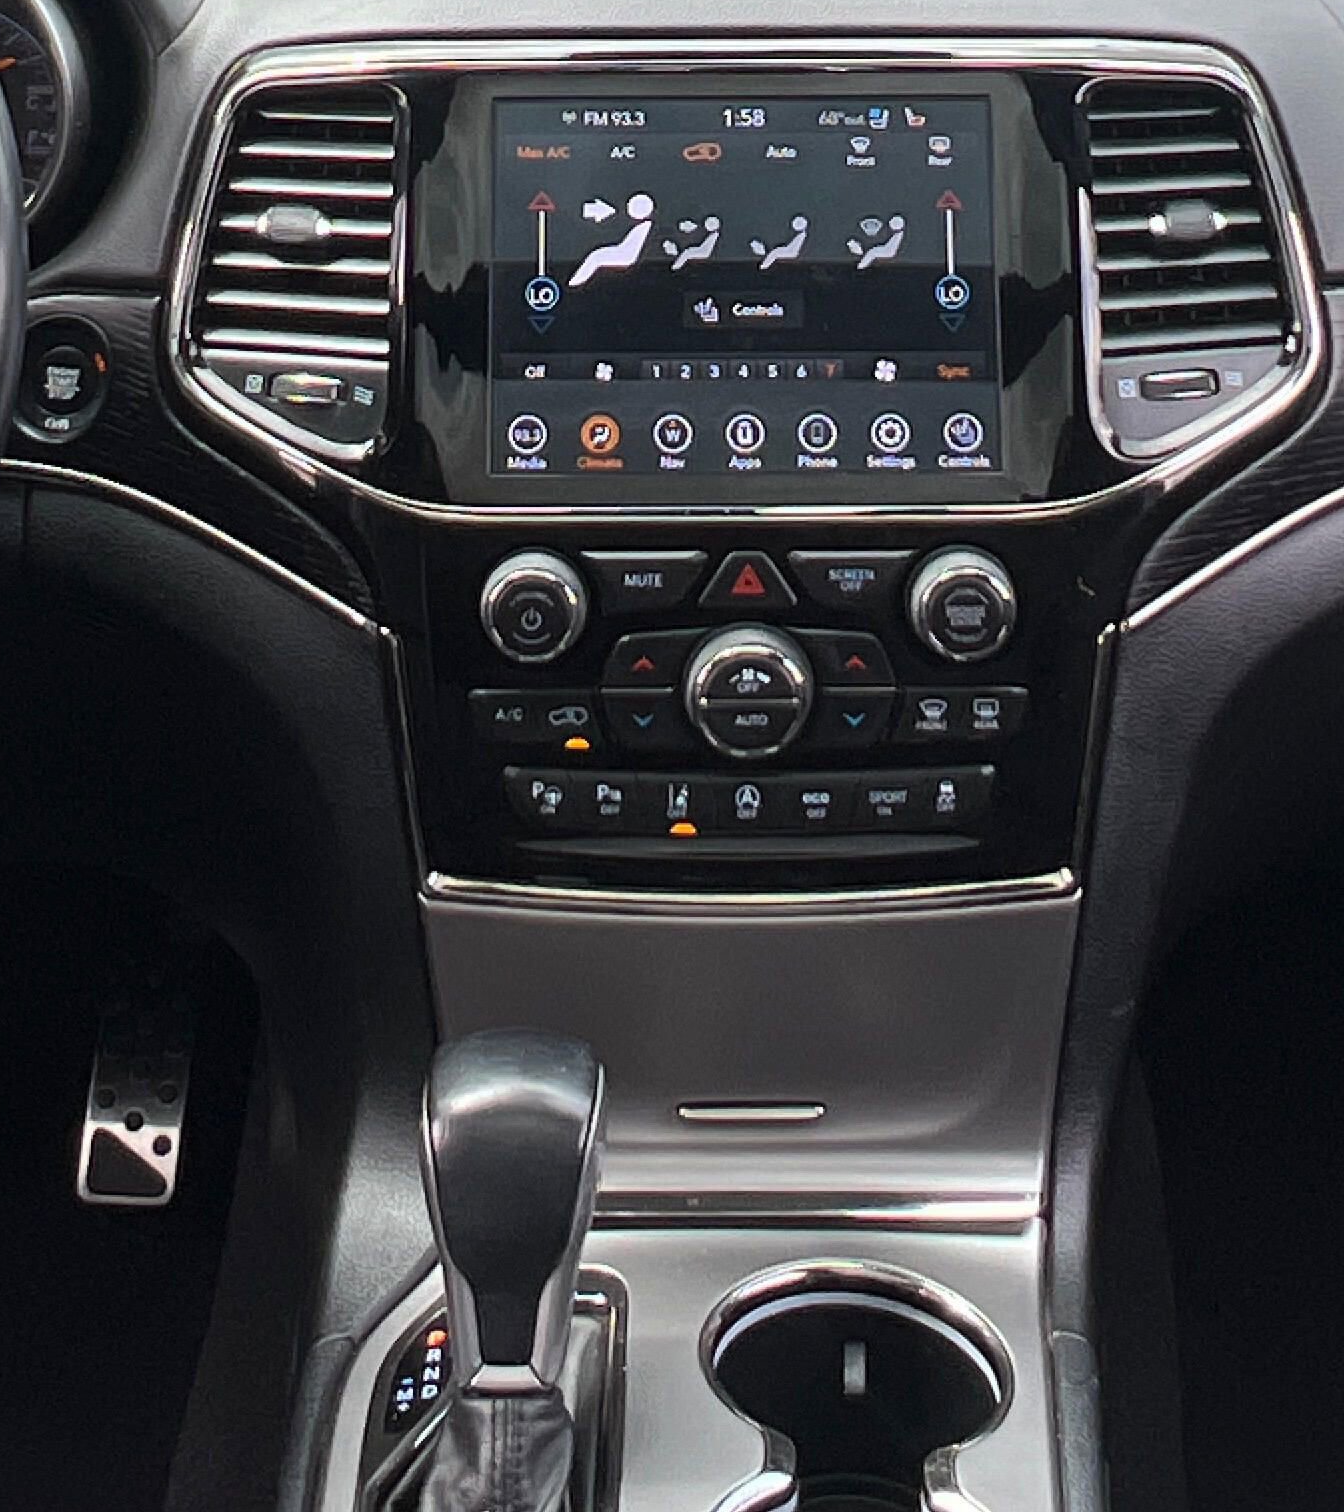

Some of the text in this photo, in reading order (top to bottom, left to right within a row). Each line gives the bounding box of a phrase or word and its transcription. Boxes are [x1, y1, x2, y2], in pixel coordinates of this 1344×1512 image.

[584, 111, 645, 125] FM 93.3
[723, 109, 765, 128] 1:58
[610, 145, 635, 158] A/C
[765, 144, 797, 159] Auto
[531, 287, 553, 301] LO
[940, 287, 963, 300] LO
[732, 303, 784, 318] Controls
[652, 364, 661, 377] 1
[680, 364, 692, 377] 2
[709, 364, 720, 377] 3
[728, 455, 762, 471] Apps
[797, 455, 837, 468] Phone
[866, 455, 916, 471] Settings
[624, 573, 662, 587] MUTE
[828, 568, 874, 582] SCREEN
[495, 708, 523, 722] A/C
[734, 713, 768, 726] AUTO
